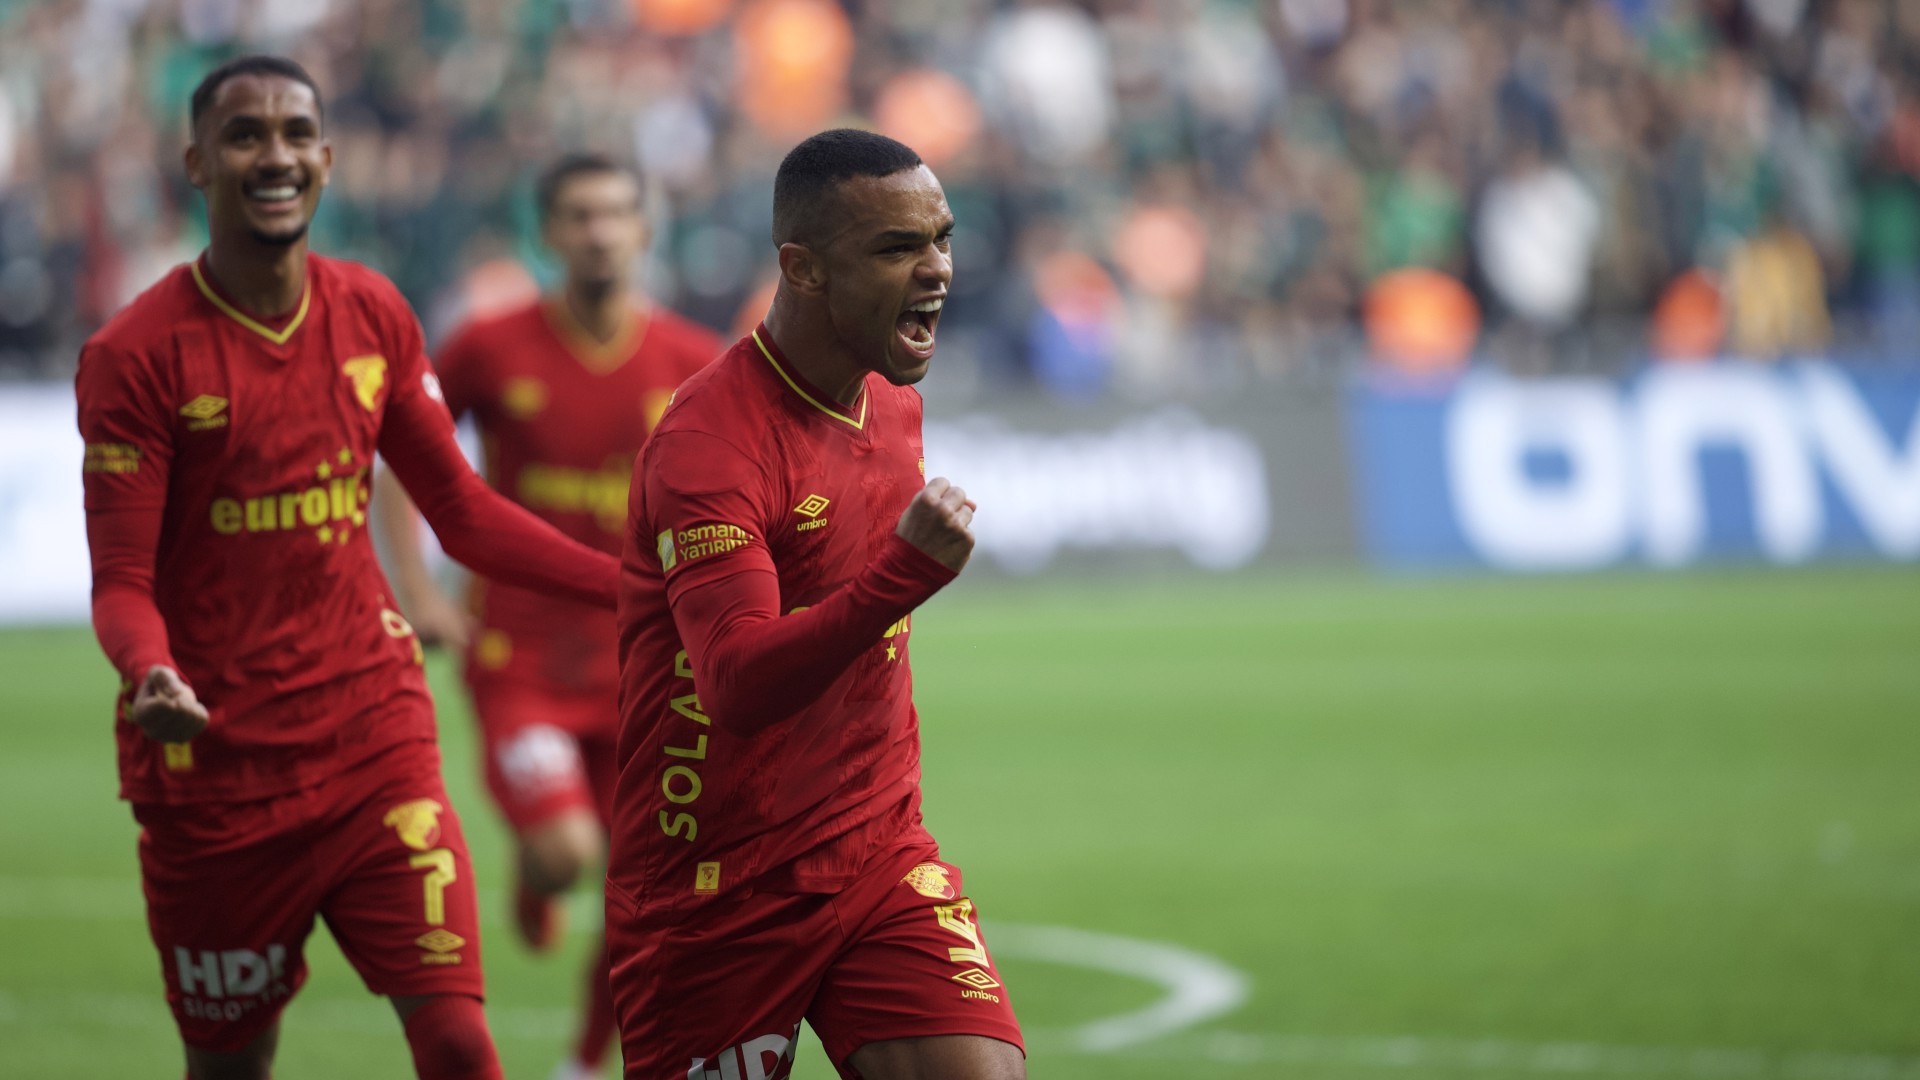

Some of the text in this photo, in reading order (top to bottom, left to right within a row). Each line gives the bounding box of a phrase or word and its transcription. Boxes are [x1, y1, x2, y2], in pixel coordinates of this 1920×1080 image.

[797, 517, 828, 531] umbro
[409, 848, 457, 926] 7
[961, 989, 1000, 1004] umbro
